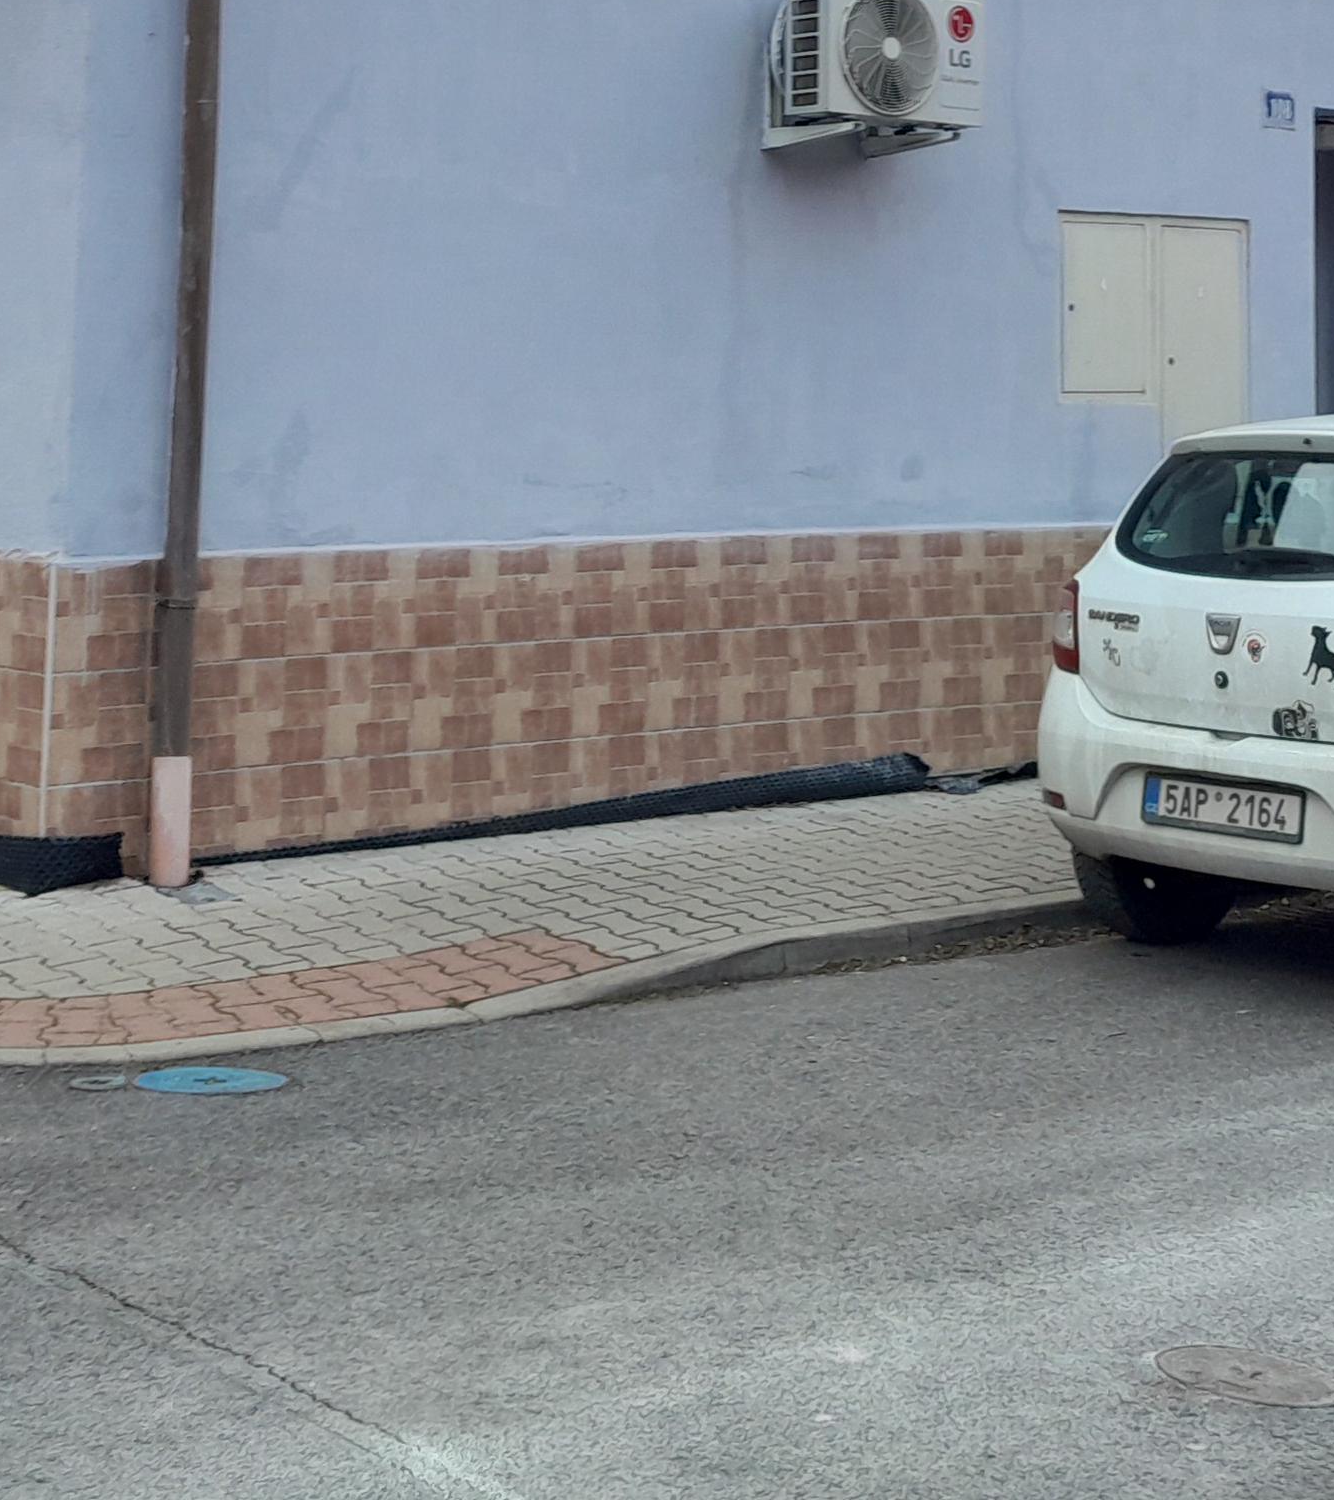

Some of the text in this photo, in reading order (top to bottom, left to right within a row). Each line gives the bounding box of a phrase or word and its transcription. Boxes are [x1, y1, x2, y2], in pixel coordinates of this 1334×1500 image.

[949, 48, 971, 68] LG
[1165, 784, 1208, 818] 5AP
[1227, 793, 1286, 830] 2164
